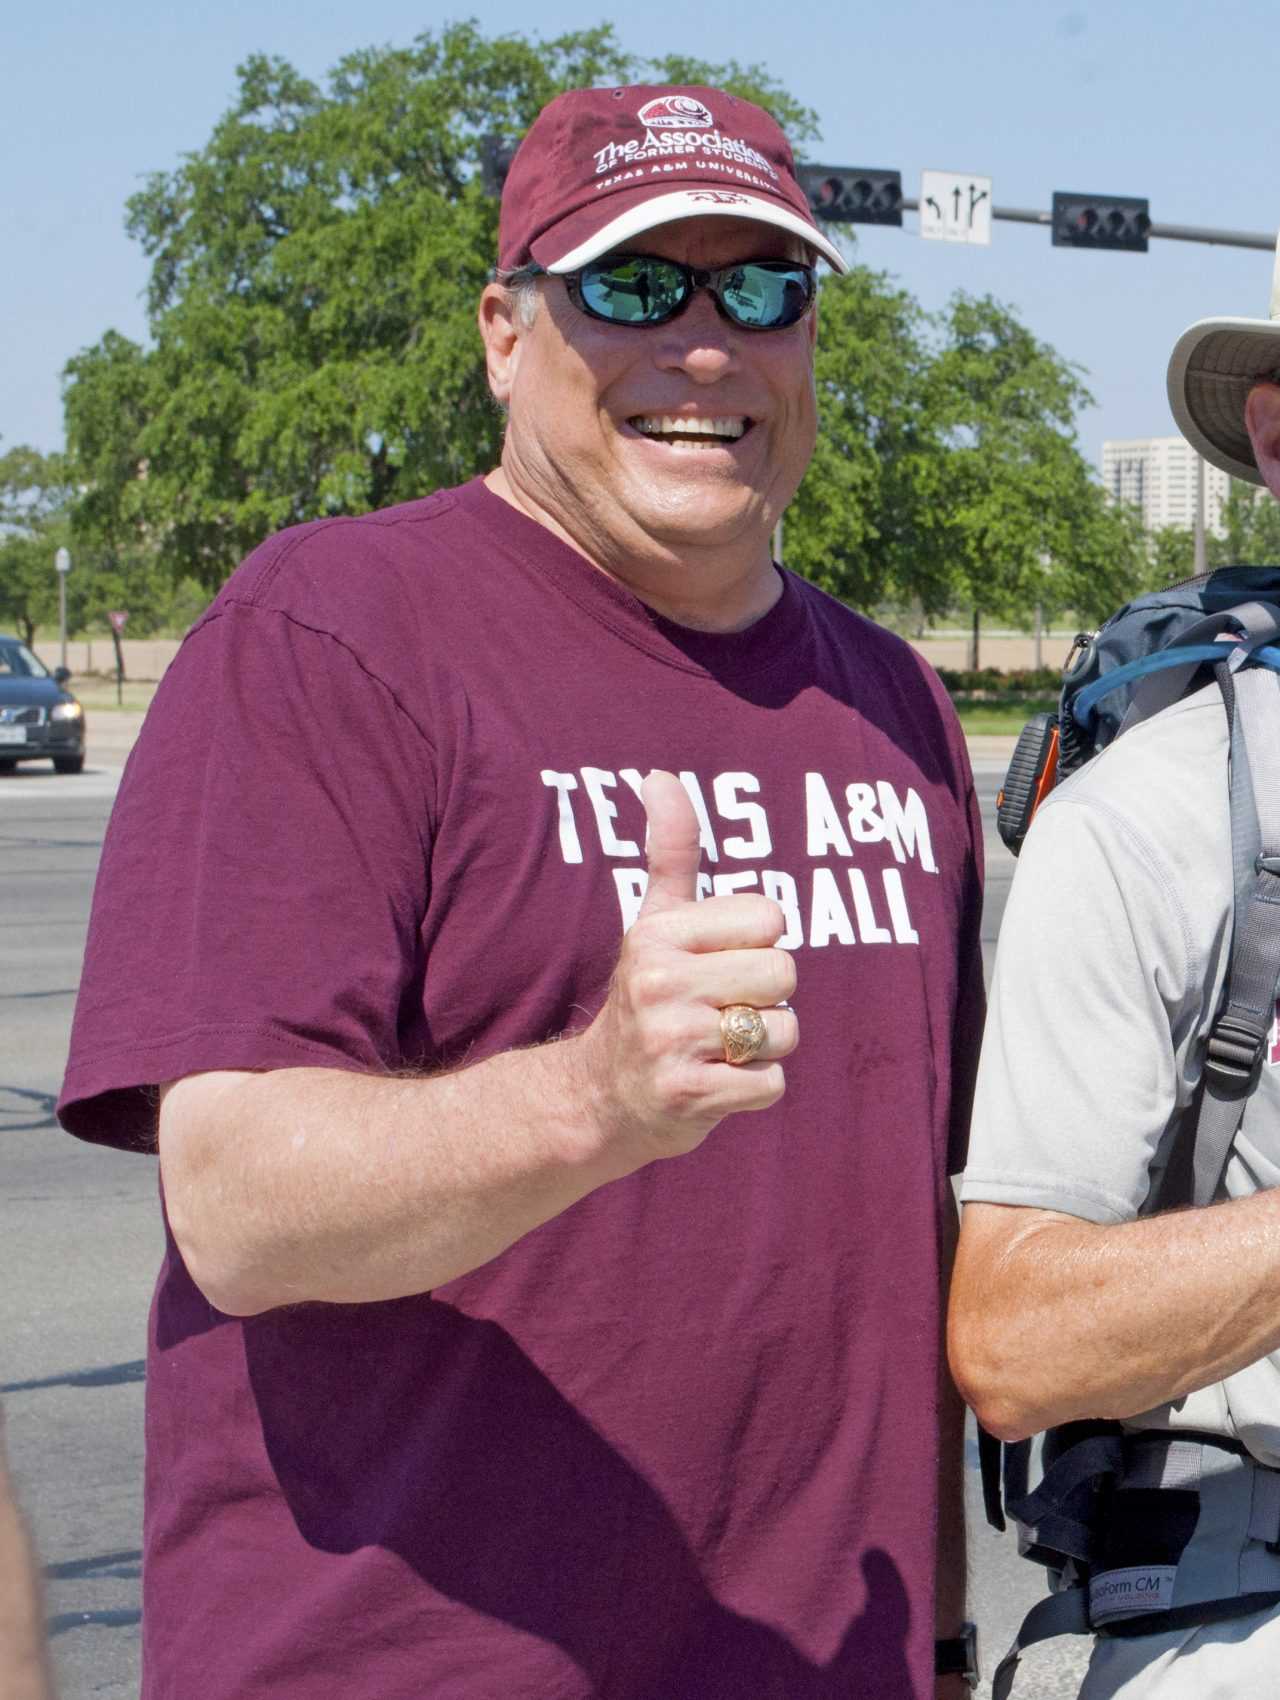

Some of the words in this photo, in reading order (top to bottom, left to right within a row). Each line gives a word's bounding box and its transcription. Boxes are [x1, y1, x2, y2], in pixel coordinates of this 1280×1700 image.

[593, 140, 640, 165] The
[640, 127, 773, 170] Association
[595, 158, 619, 174] OF
[624, 144, 697, 163] FORMER
[595, 168, 645, 190] TEXAS
[650, 162, 688, 174] A&M
[805, 772, 938, 874] A&M
[611, 867, 919, 950] BBALL
[1135, 1576, 1160, 1593] CM
